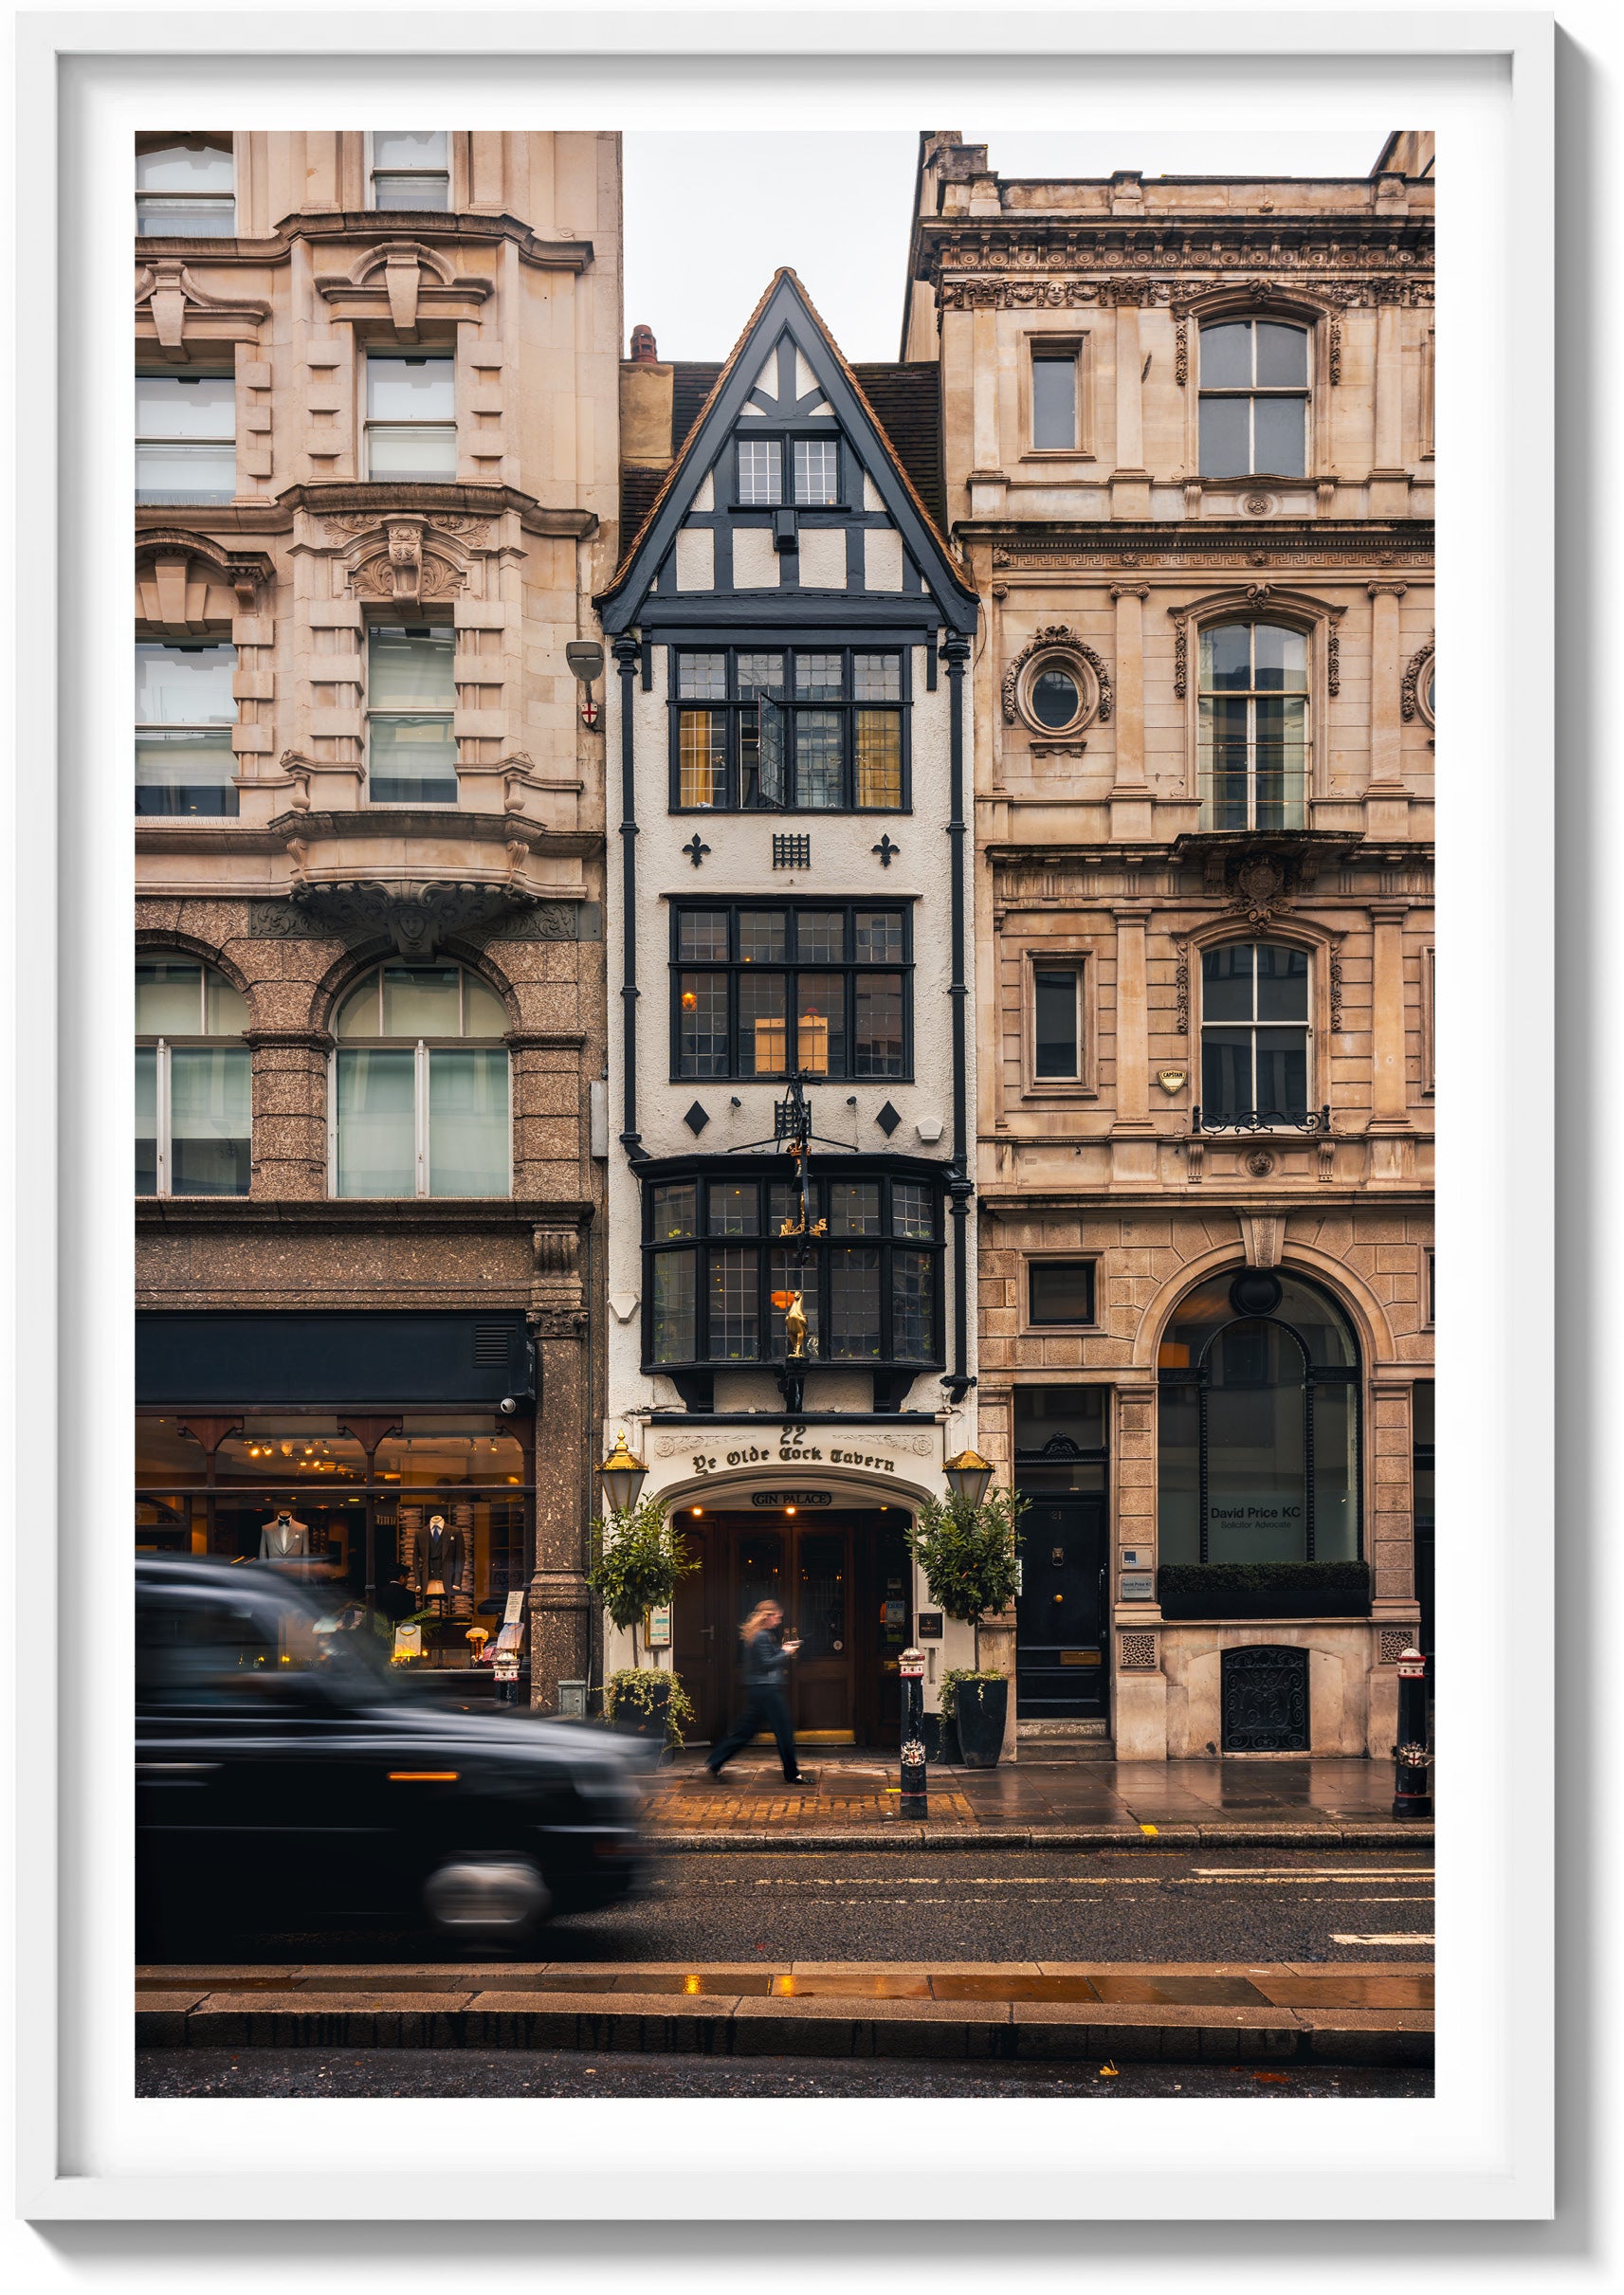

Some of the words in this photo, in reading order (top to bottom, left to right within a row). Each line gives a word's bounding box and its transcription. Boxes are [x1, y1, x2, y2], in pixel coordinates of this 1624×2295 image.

[818, 1218, 827, 1229] S
[779, 1425, 807, 1446] 22
[692, 1455, 718, 1476] Ye
[726, 1446, 770, 1466] Olde
[778, 1446, 823, 1462] Cock
[830, 1448, 895, 1472] Tavern
[756, 1494, 778, 1504] GIN
[783, 1494, 828, 1504] PALACE
[1211, 1507, 1244, 1519] David
[1248, 1507, 1278, 1518] Price
[1282, 1506, 1301, 1518] KC
[1221, 1521, 1252, 1529] Solicitor
[1254, 1521, 1291, 1529] Advocate
